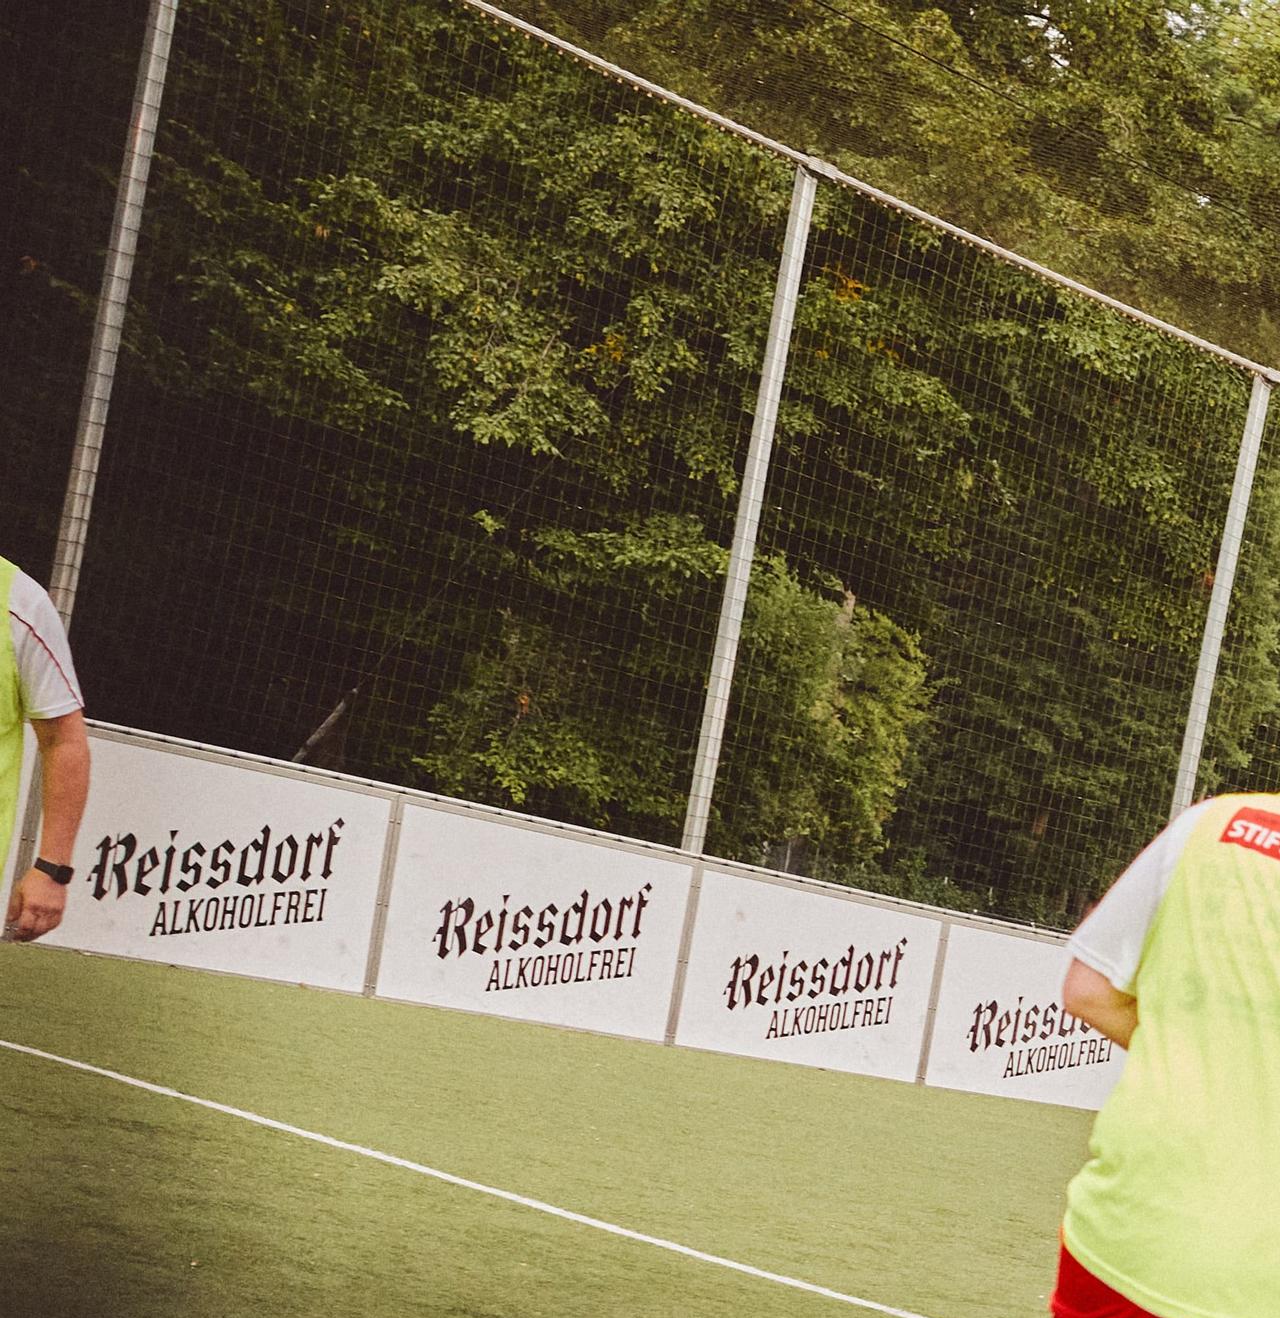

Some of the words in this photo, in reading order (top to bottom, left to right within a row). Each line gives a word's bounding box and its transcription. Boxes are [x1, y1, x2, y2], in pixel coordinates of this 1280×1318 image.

[88, 817, 345, 901] Reissdorf
[149, 888, 327, 937] ALKOHOLFREI
[433, 882, 653, 960] Reissdorf
[485, 946, 637, 992] ALKOHOLFREI
[723, 937, 908, 1011] Reissdorf
[765, 996, 893, 1040] ALKOHOLFREI
[1003, 1037, 1113, 1079] ALKOHOLFREI
